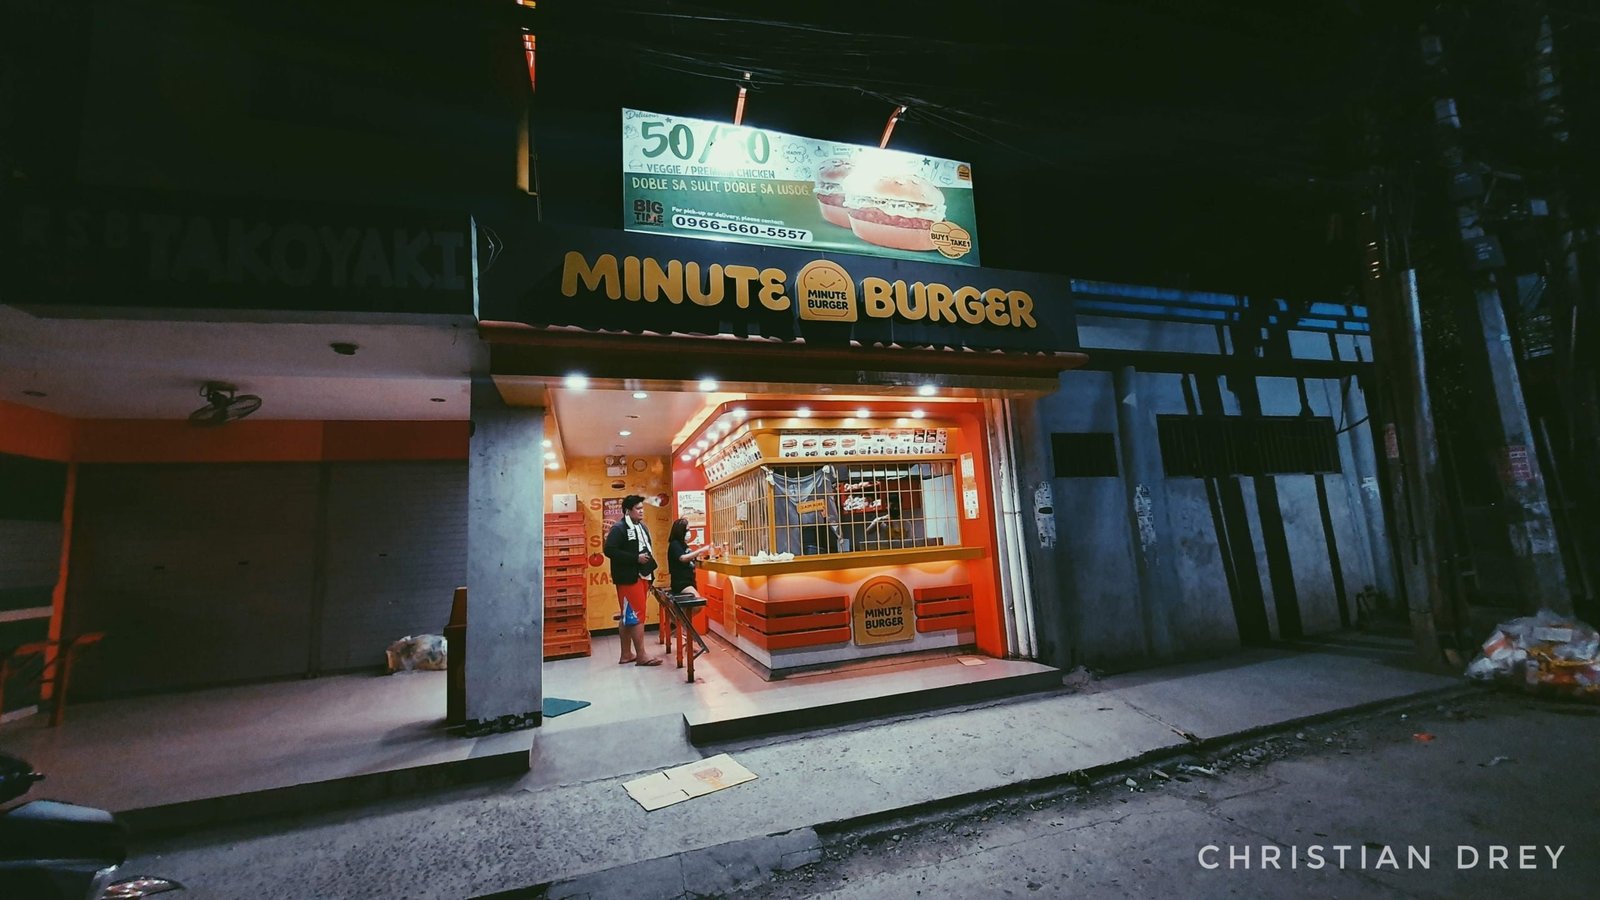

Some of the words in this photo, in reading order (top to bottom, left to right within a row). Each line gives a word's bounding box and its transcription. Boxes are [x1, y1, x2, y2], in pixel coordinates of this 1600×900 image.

[641, 121, 770, 164] 50/0
[647, 163, 681, 174] VEGGIE
[737, 168, 776, 179] CHICKEN
[632, 177, 668, 190] DOBLE
[672, 179, 688, 191] SA
[724, 181, 757, 194] DOBLE
[760, 183, 775, 195] SA
[633, 199, 664, 215] BIG
[634, 212, 664, 224] TIME
[683, 208, 706, 217] pick-up
[741, 215, 761, 223] please
[676, 216, 807, 240] 0966-660-5557
[139, 212, 466, 291] TAKOYAKI
[561, 251, 790, 311] MINUTE
[863, 277, 1037, 328] BURGER
[807, 289, 847, 300] MINUTE
[807, 299, 849, 310] BURGER
[590, 571, 612, 586] KA
[865, 606, 903, 618] MINUTE
[865, 617, 904, 629] BURGER
